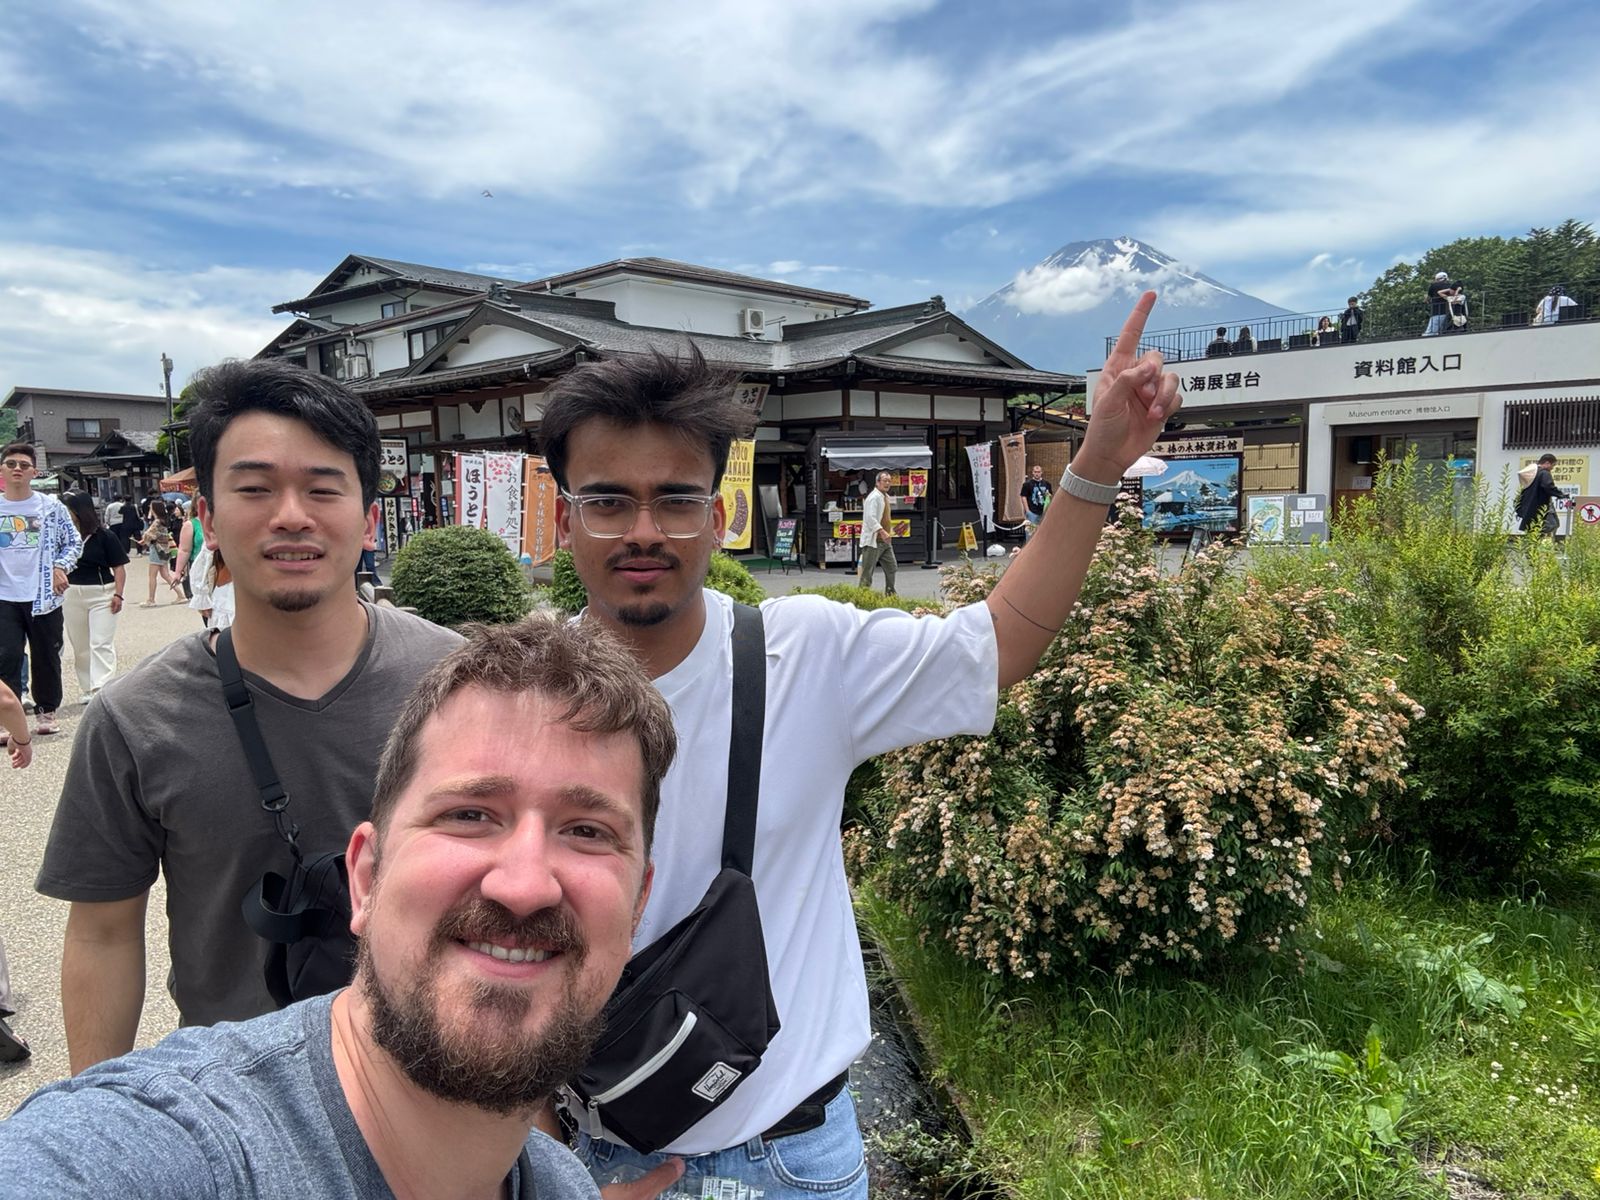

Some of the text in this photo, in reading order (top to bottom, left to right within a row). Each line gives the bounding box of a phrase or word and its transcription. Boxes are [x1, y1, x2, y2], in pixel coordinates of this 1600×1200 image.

[1354, 354, 1461, 378] 資料館入口
[1348, 410, 1379, 418] Museum
[1380, 408, 1412, 416] entrance
[380, 455, 405, 465] うとう
[726, 461, 750, 476] ANANA
[506, 470, 519, 529] お食事処
[43, 566, 52, 600] ADIDAS
